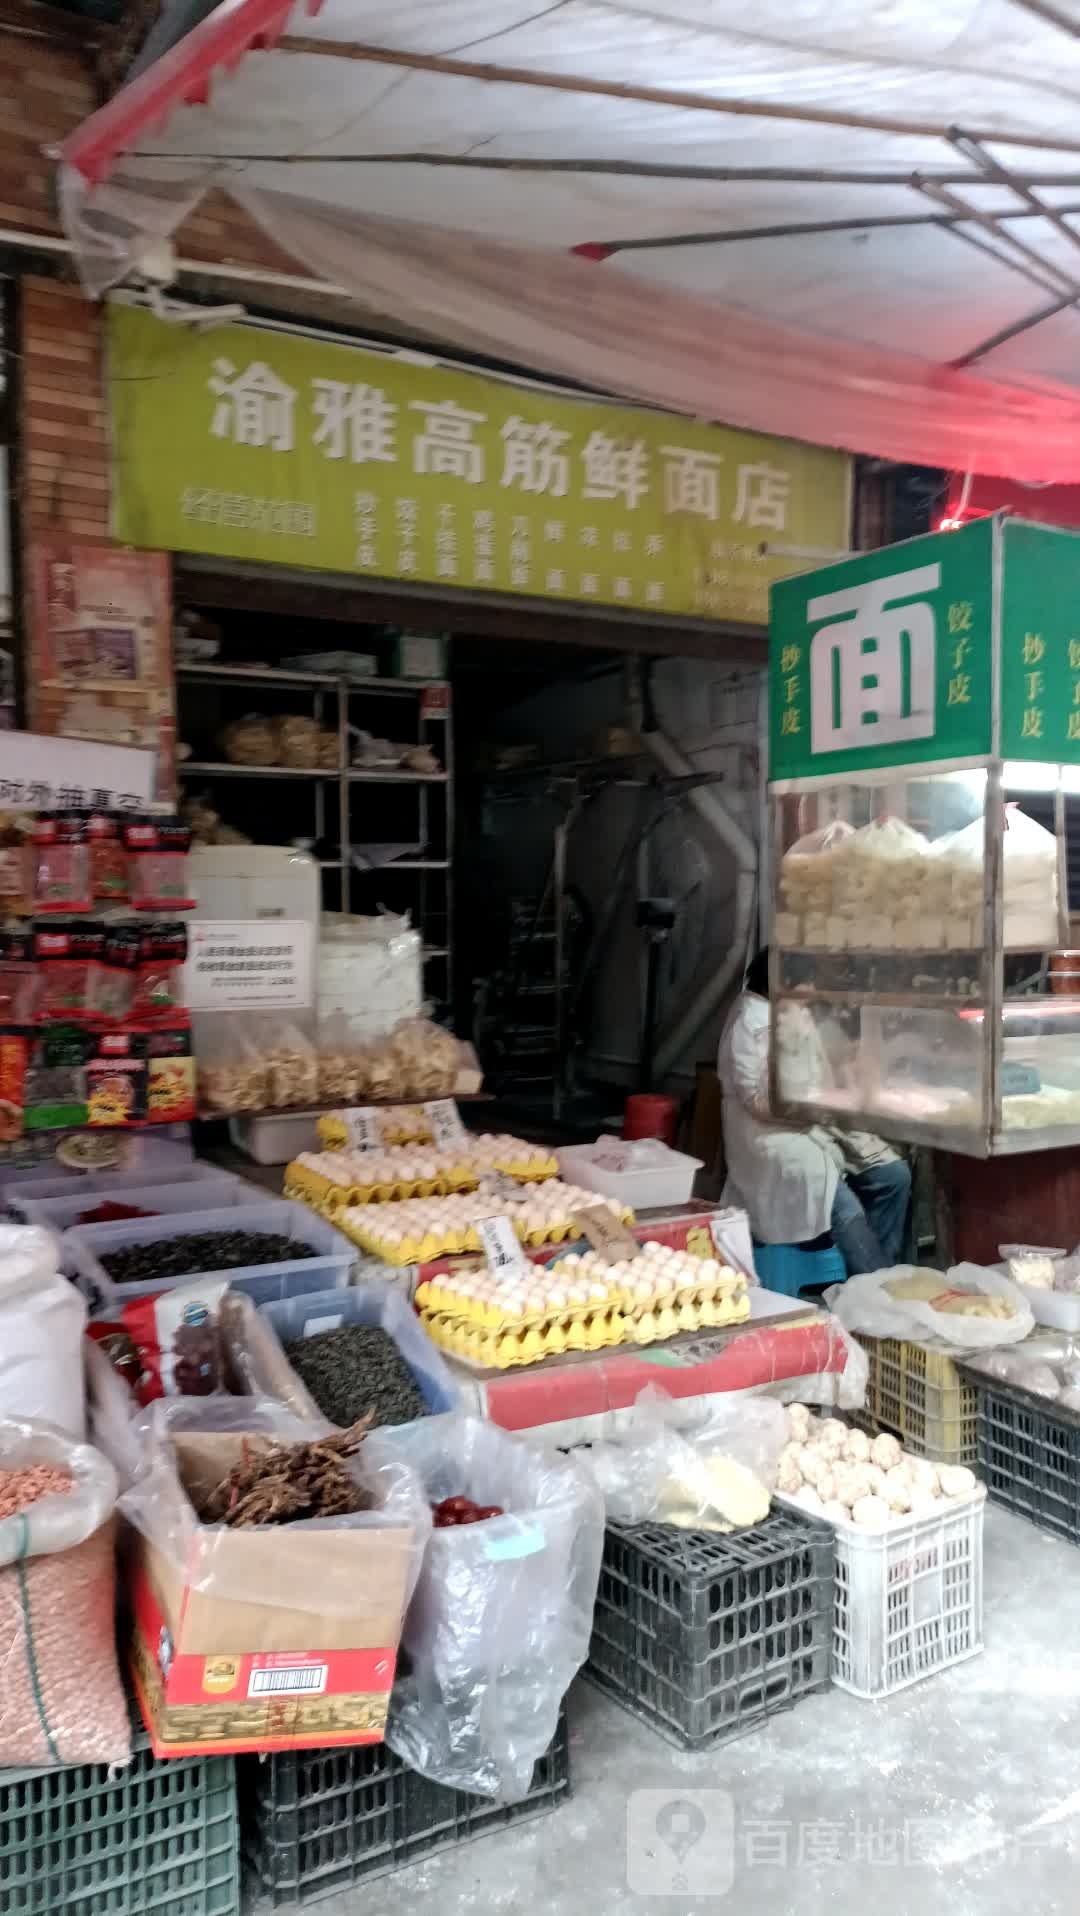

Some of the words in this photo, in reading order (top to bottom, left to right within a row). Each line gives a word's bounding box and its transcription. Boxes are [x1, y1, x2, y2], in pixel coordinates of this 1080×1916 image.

[207, 357, 791, 531] 渝雅高筋鲜面店
[780, 644, 800, 735] 抄手皮
[806, 561, 942, 753] 面
[947, 601, 974, 705] 饺子皮
[1020, 632, 1046, 738] 抄手皮
